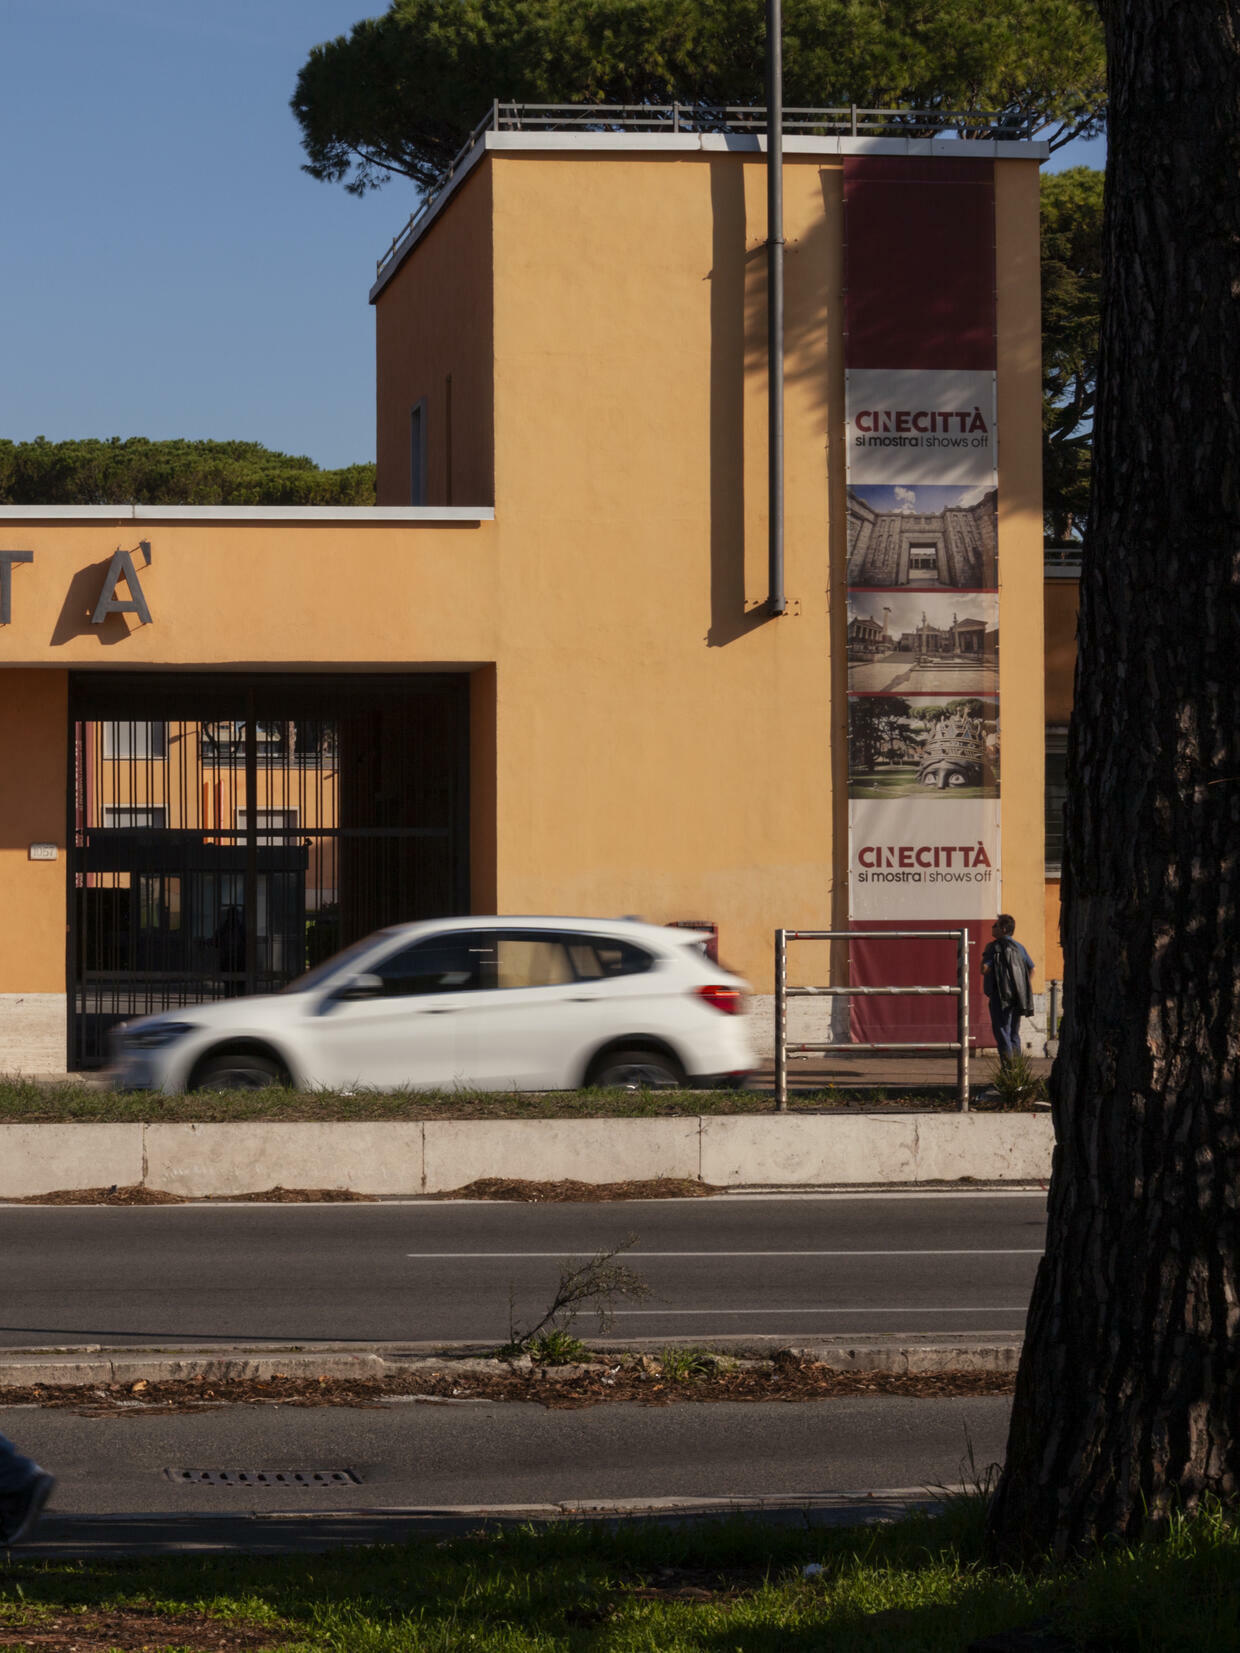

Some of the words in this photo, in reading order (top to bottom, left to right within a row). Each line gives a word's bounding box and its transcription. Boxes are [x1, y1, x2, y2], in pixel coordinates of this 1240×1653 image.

[855, 406, 988, 433] CINECITTÀ
[855, 434, 866, 447] si
[868, 435, 919, 447] mostra
[925, 435, 969, 447] shows
[971, 435, 988, 447] off
[33, 846, 55, 857] 1057
[858, 840, 992, 868] CINECITTÀ
[858, 870, 869, 882] si
[871, 870, 922, 882] mostra
[929, 870, 972, 882] shows
[974, 870, 992, 882] off
